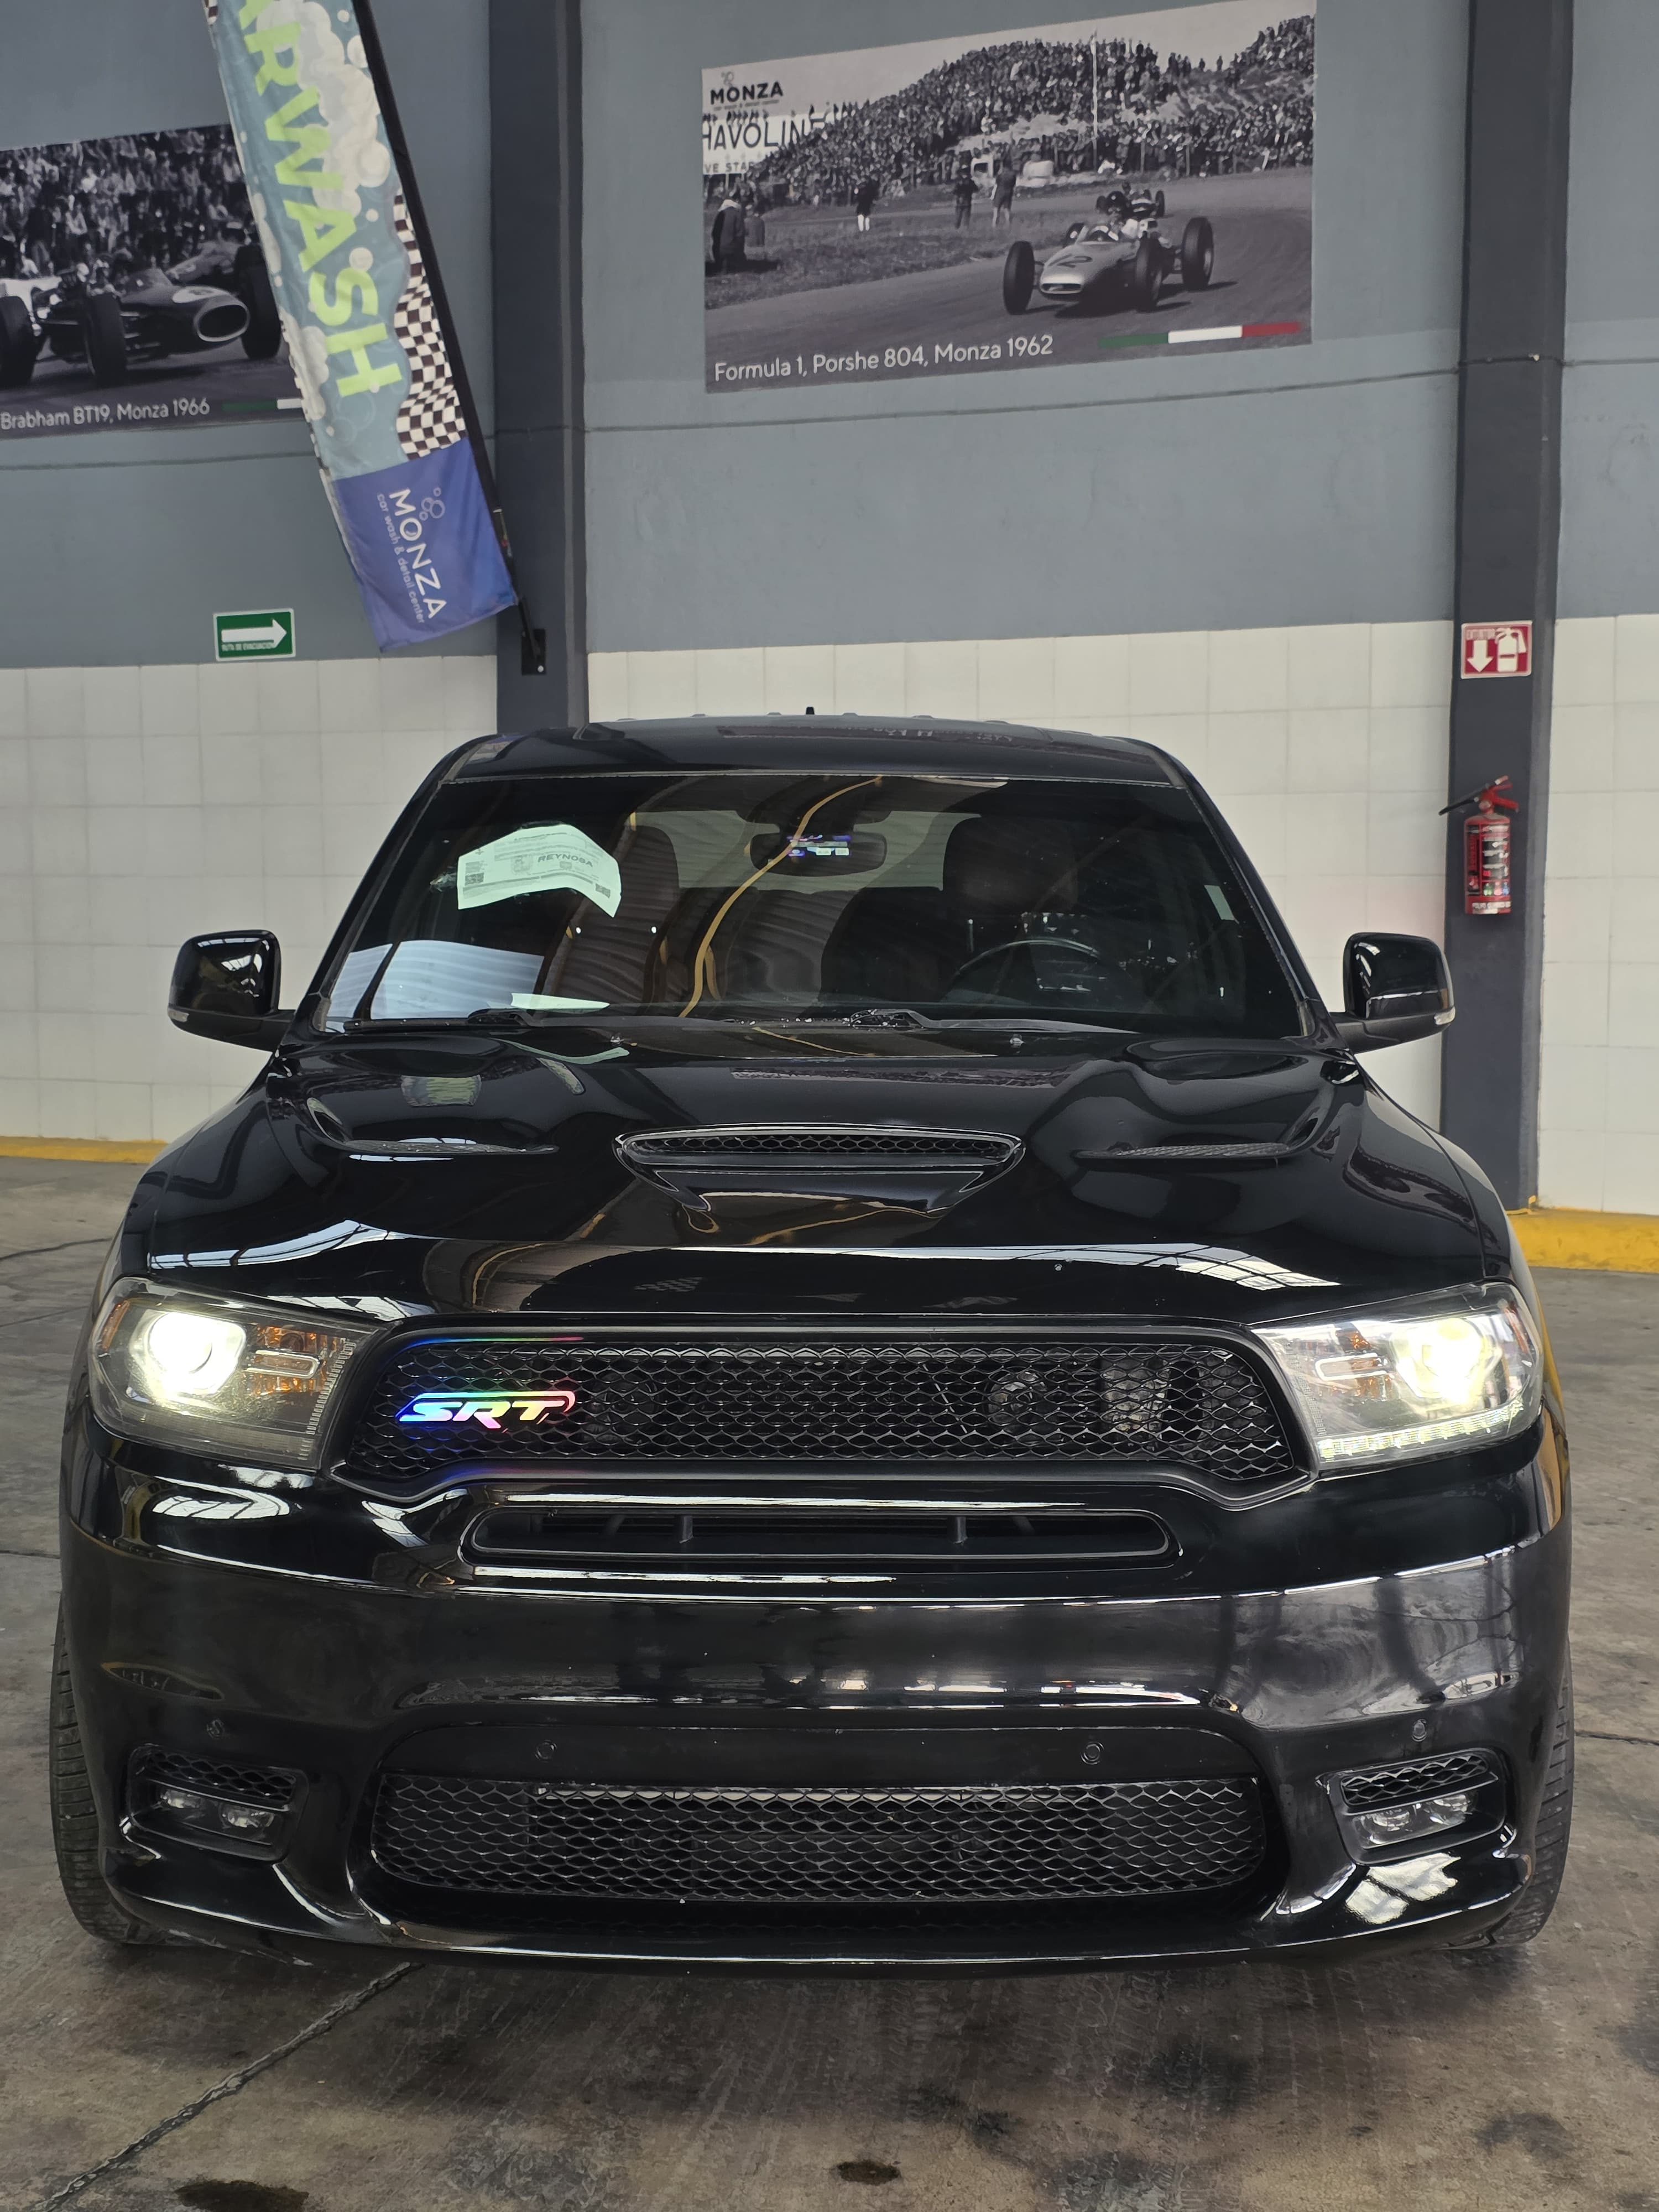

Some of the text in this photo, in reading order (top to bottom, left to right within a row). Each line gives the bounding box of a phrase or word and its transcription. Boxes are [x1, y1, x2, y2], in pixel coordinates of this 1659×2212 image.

[710, 81, 784, 105] MONZA
[714, 333, 1053, 382] Formula 1, Porshe 804, Monza 1962
[0, 397, 211, 430] Brabham BT19, Monza 1966
[377, 493, 389, 512] car
[384, 515, 401, 545] wash
[398, 556, 415, 589] detail
[409, 591, 425, 623] center
[389, 488, 447, 619] MONZA
[398, 1398, 567, 1430] SRT
